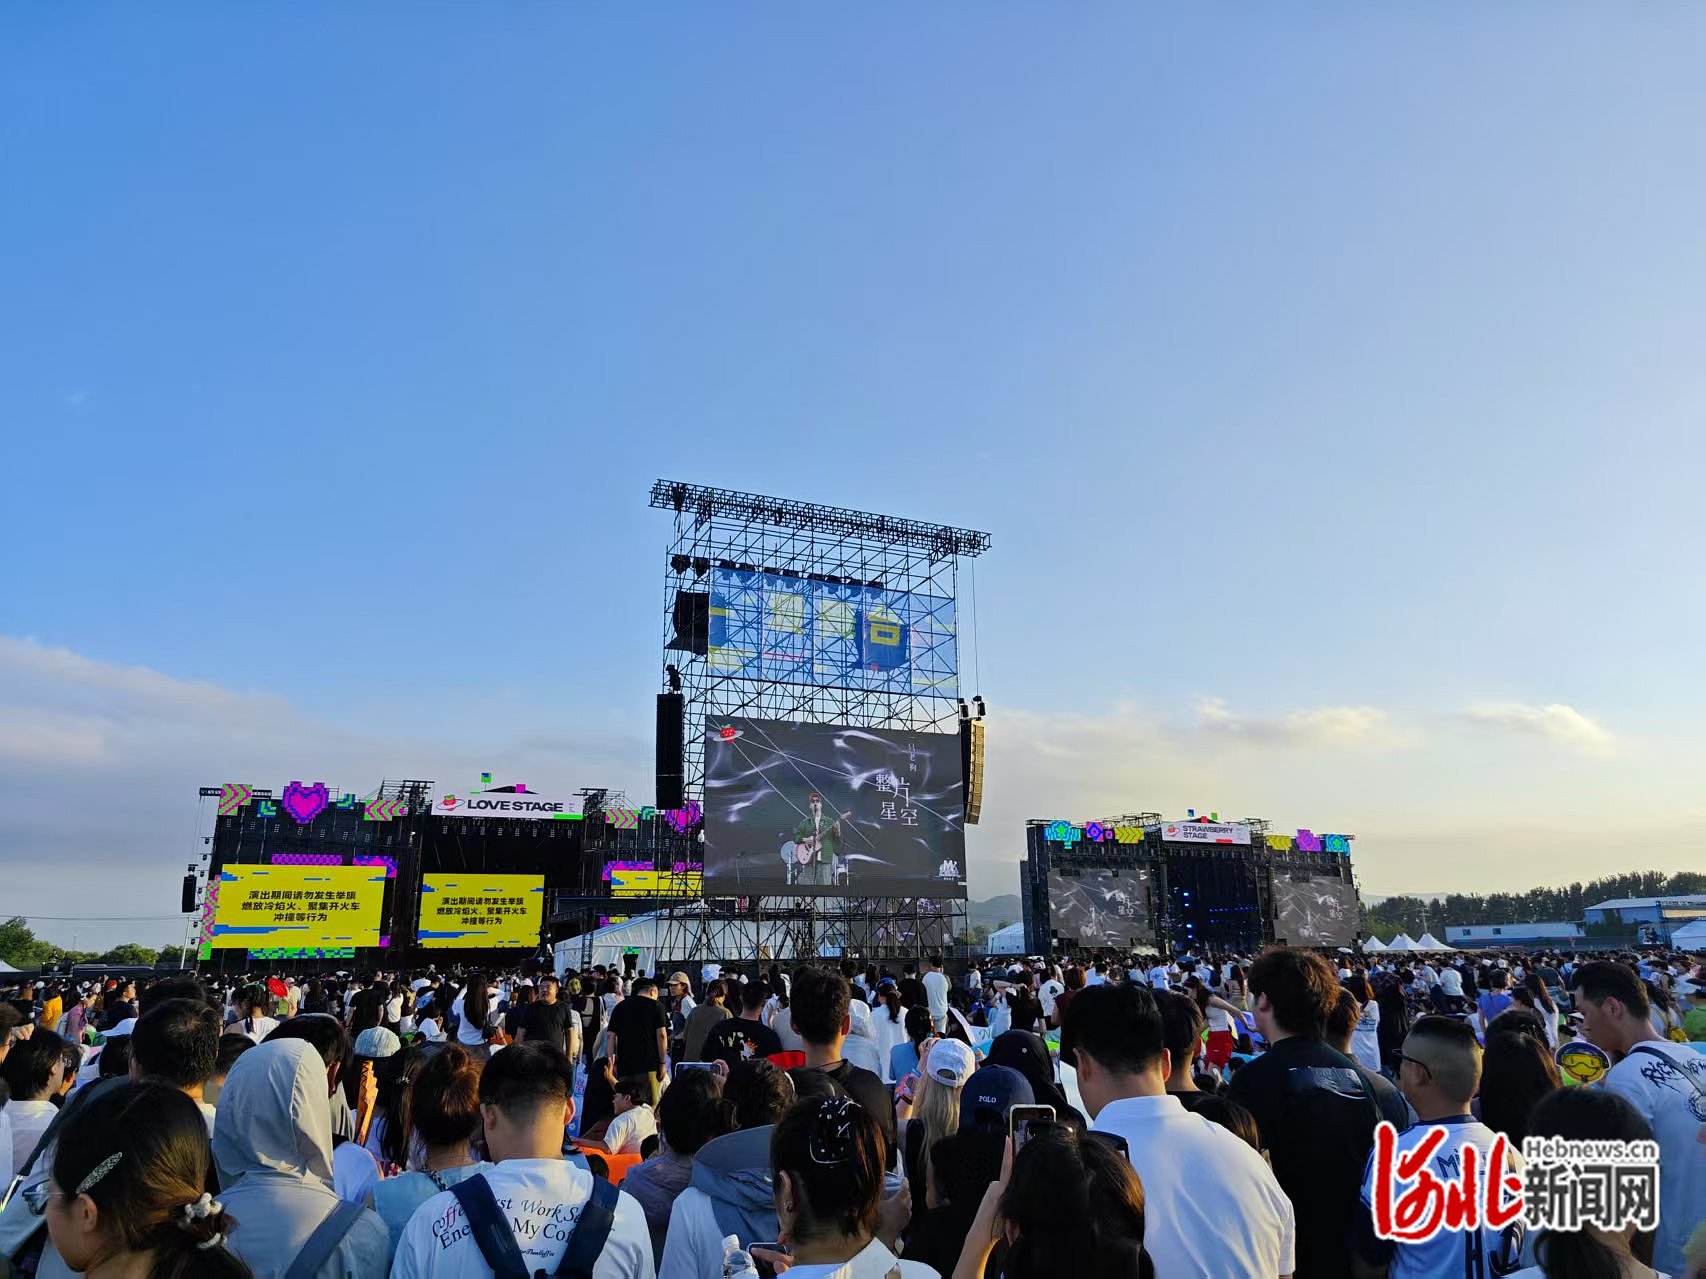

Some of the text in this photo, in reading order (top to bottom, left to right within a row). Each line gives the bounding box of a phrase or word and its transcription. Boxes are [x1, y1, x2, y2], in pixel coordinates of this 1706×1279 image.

[467, 799, 510, 811] LOVE
[512, 801, 563, 813] STAGE
[880, 801, 919, 826] 星空
[1182, 825, 1233, 834] STRAWBERRY
[273, 912, 327, 922] 冲撞等行为
[978, 1095, 997, 1104] POLO
[520, 1199, 563, 1224] Work
[440, 1224, 471, 1250] Ene
[512, 1217, 540, 1240] My
